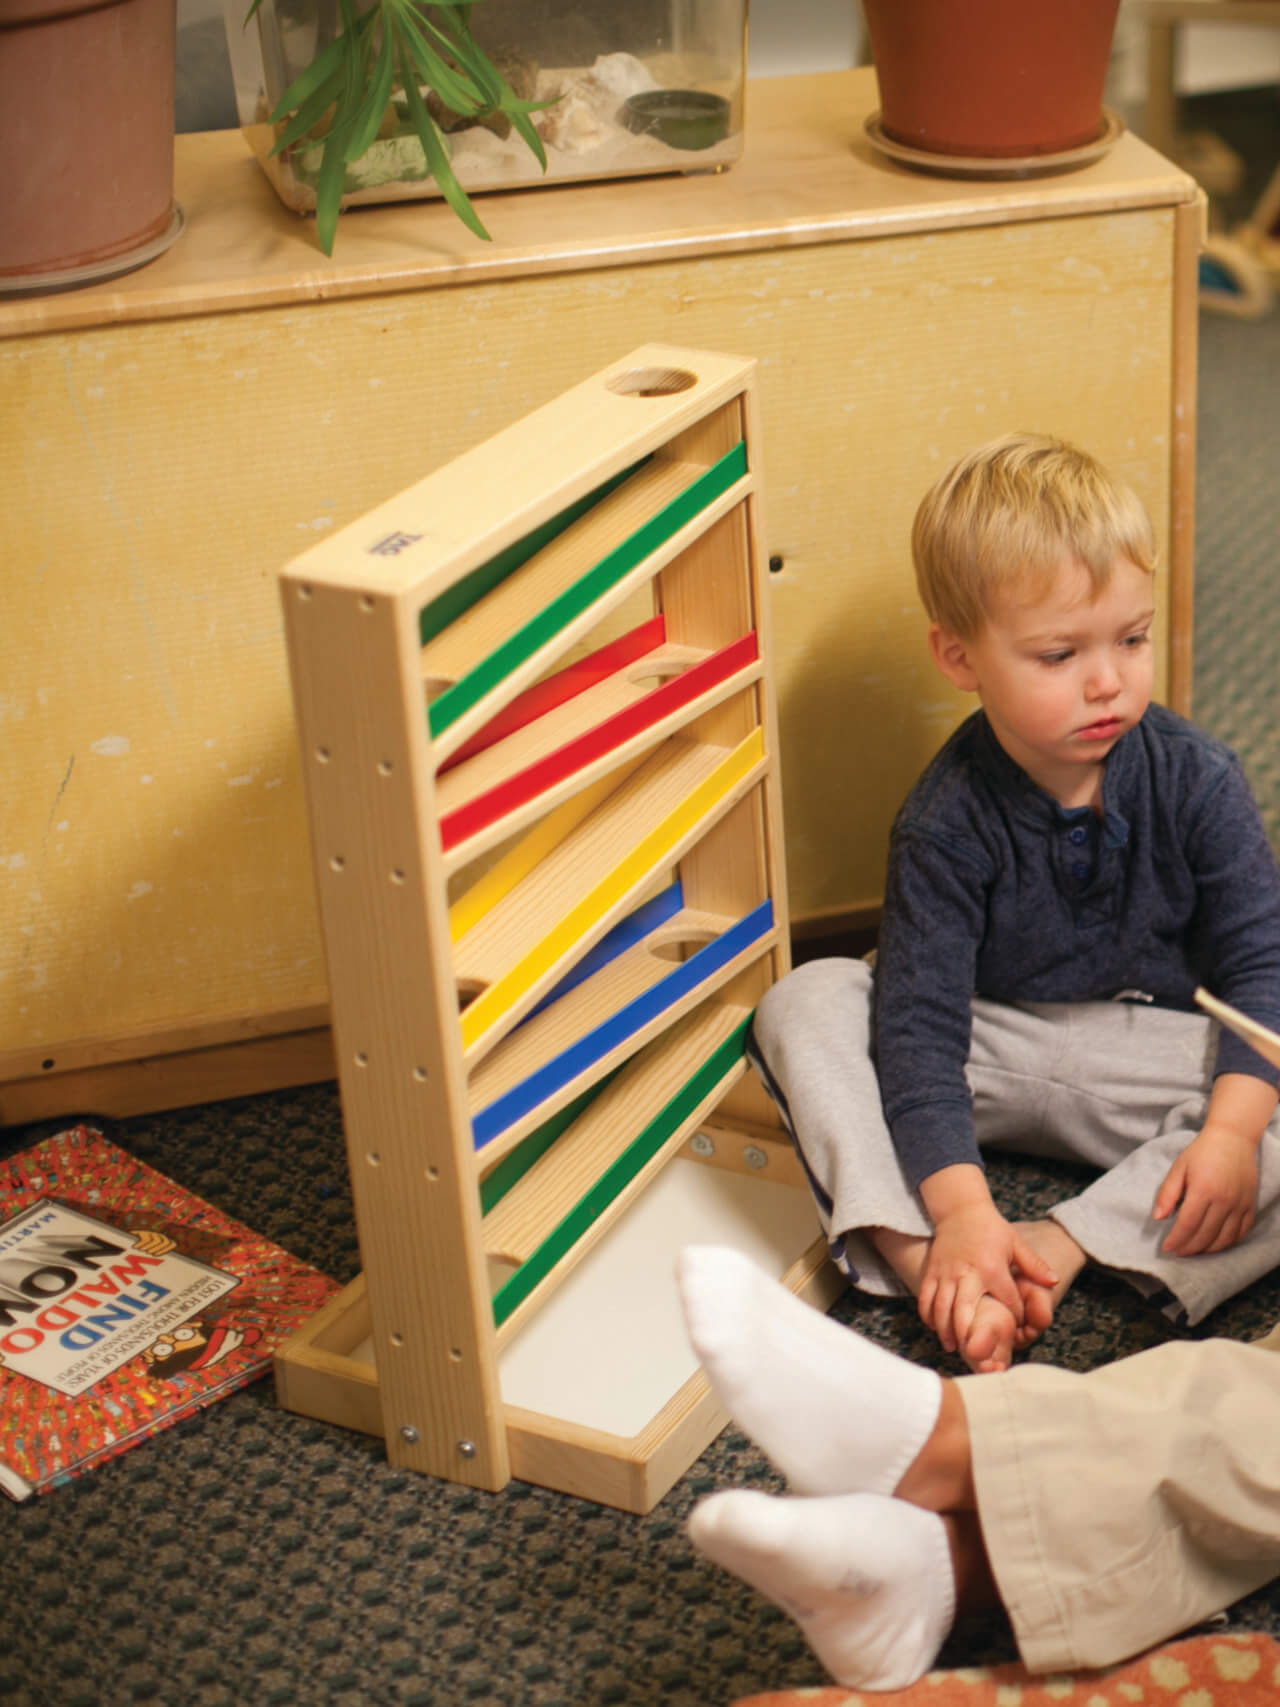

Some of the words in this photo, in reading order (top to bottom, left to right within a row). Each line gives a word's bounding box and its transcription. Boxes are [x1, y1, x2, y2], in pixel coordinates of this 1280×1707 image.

[178, 1275, 213, 1298] HIDDEN
[199, 1279, 227, 1299] LOST
[0, 1254, 165, 1354] WALDO
[60, 1279, 171, 1350] FIND
[149, 1296, 181, 1319] AMONG
[177, 1297, 203, 1314] FOR
[99, 1317, 150, 1353] THOUSANDS
[116, 1311, 181, 1353] THOUSANDS
[102, 1352, 120, 1366] OF
